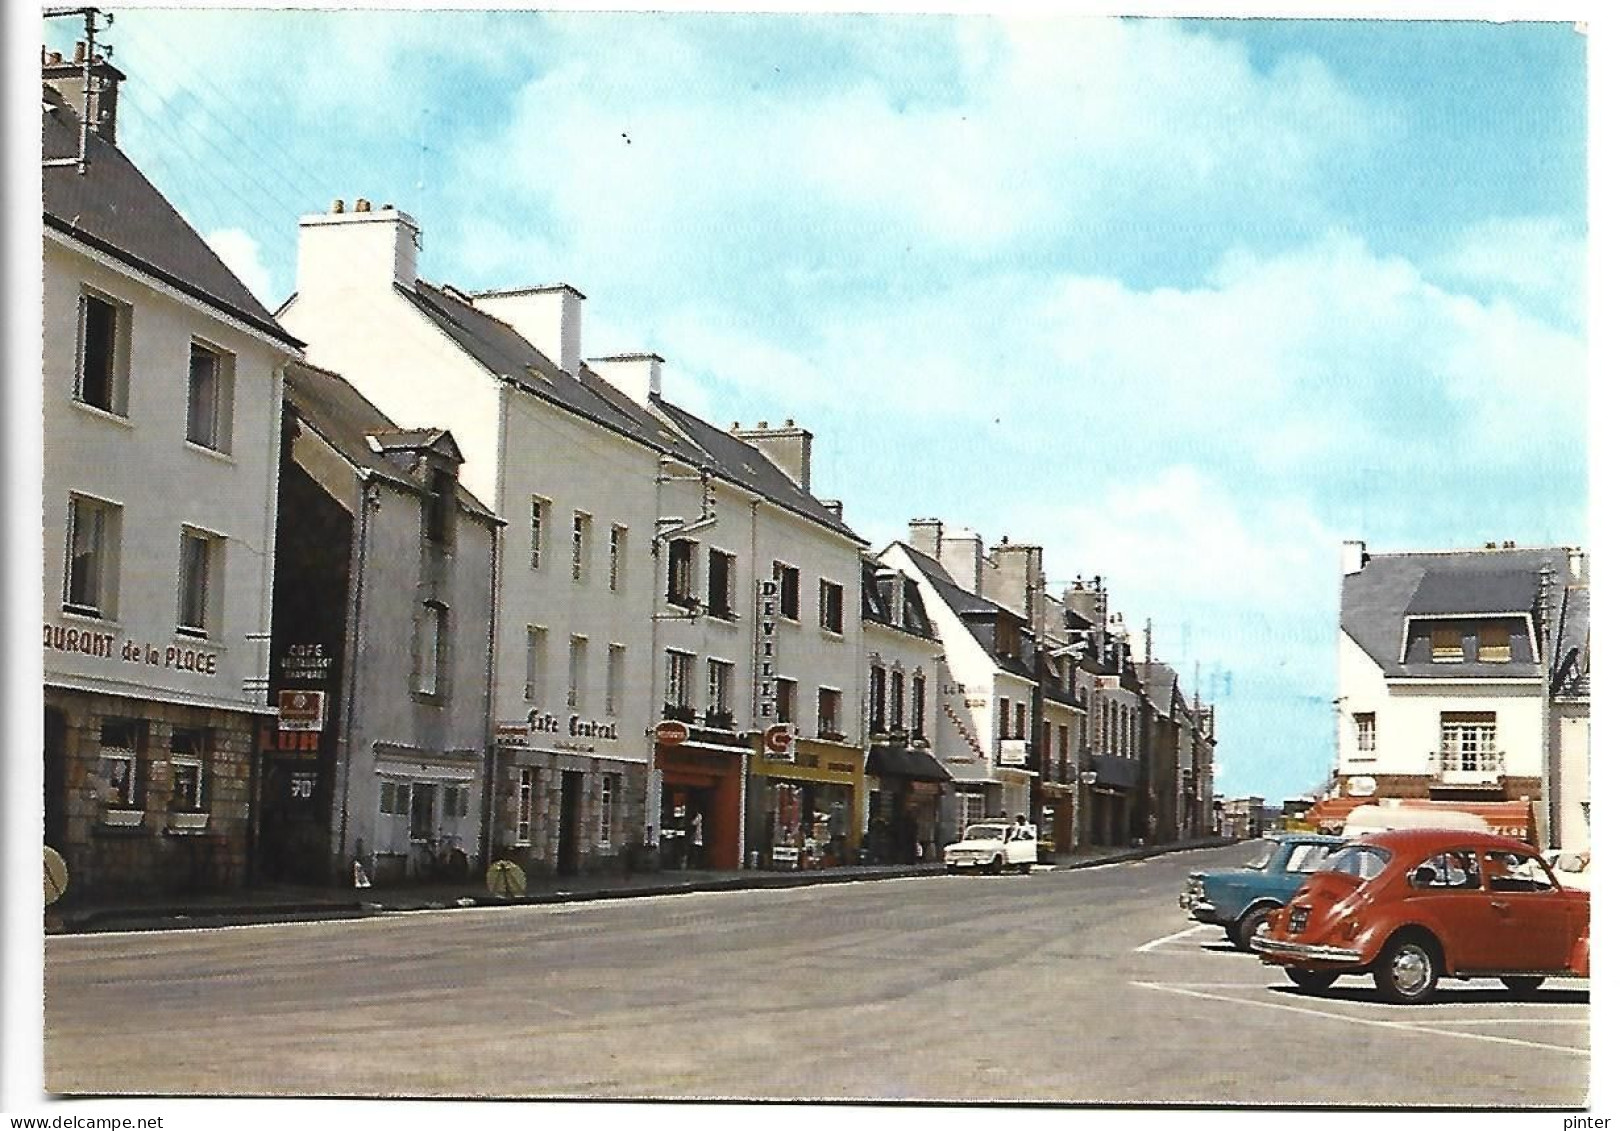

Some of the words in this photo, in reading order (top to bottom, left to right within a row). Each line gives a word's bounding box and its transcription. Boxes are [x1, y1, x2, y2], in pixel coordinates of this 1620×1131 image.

[121, 640, 141, 662] de
[145, 644, 160, 666] la
[164, 647, 217, 675] PLACE
[760, 580, 778, 718] DEVILLE
